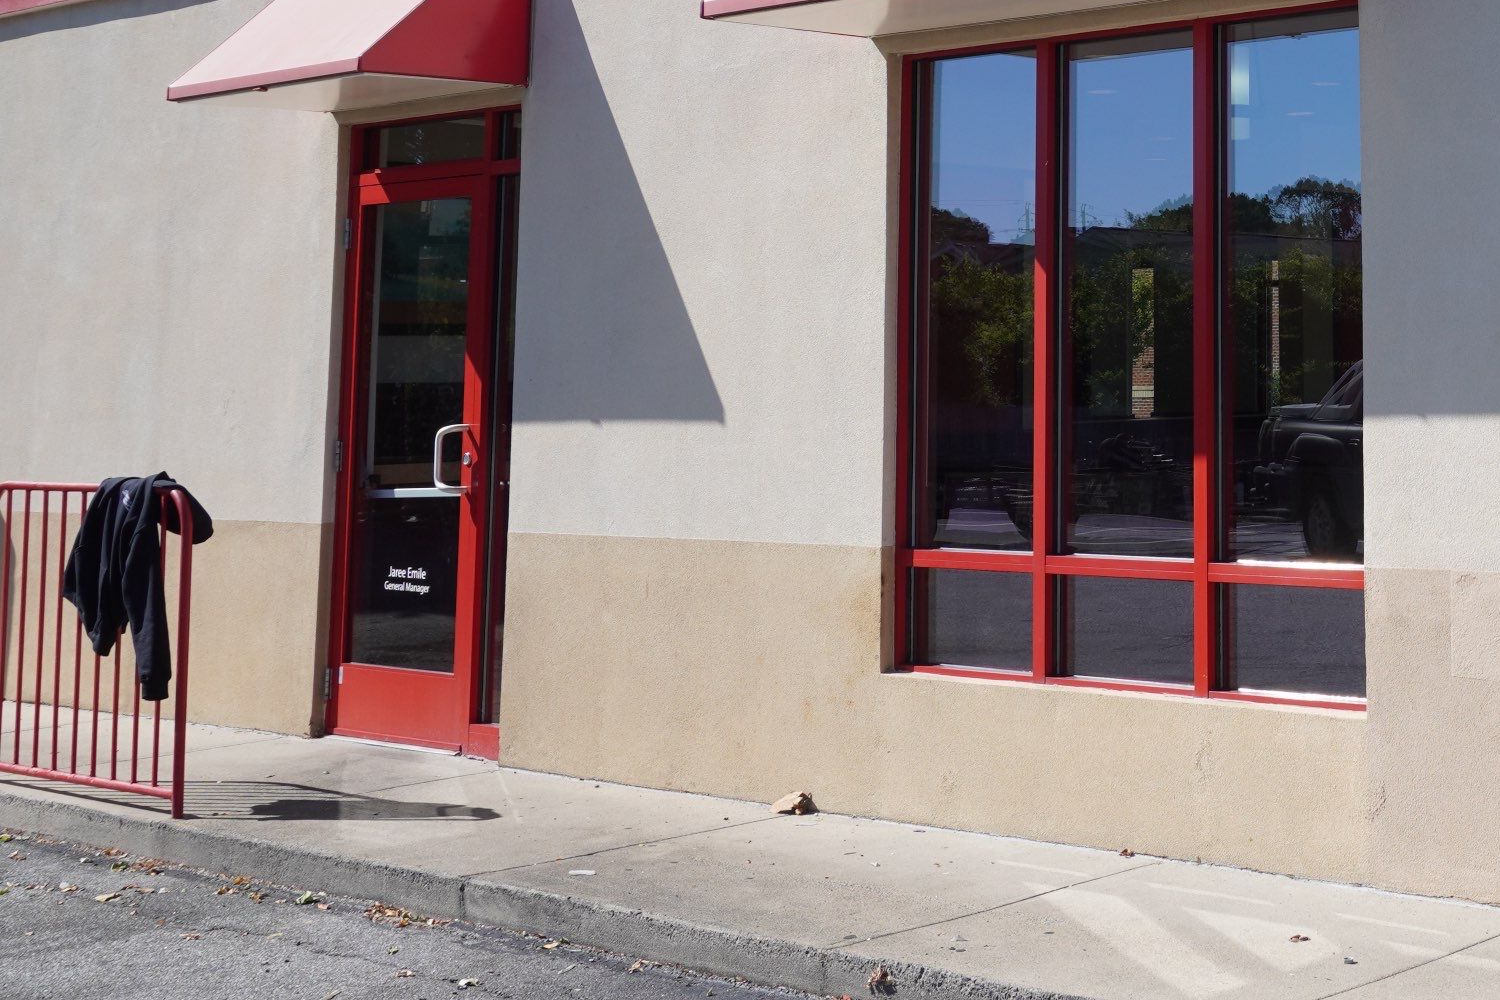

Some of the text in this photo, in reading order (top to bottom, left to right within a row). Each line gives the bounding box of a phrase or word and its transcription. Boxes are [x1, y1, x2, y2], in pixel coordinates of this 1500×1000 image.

[388, 565, 426, 579] Jaree Emile
[384, 580, 430, 595] General Manager
